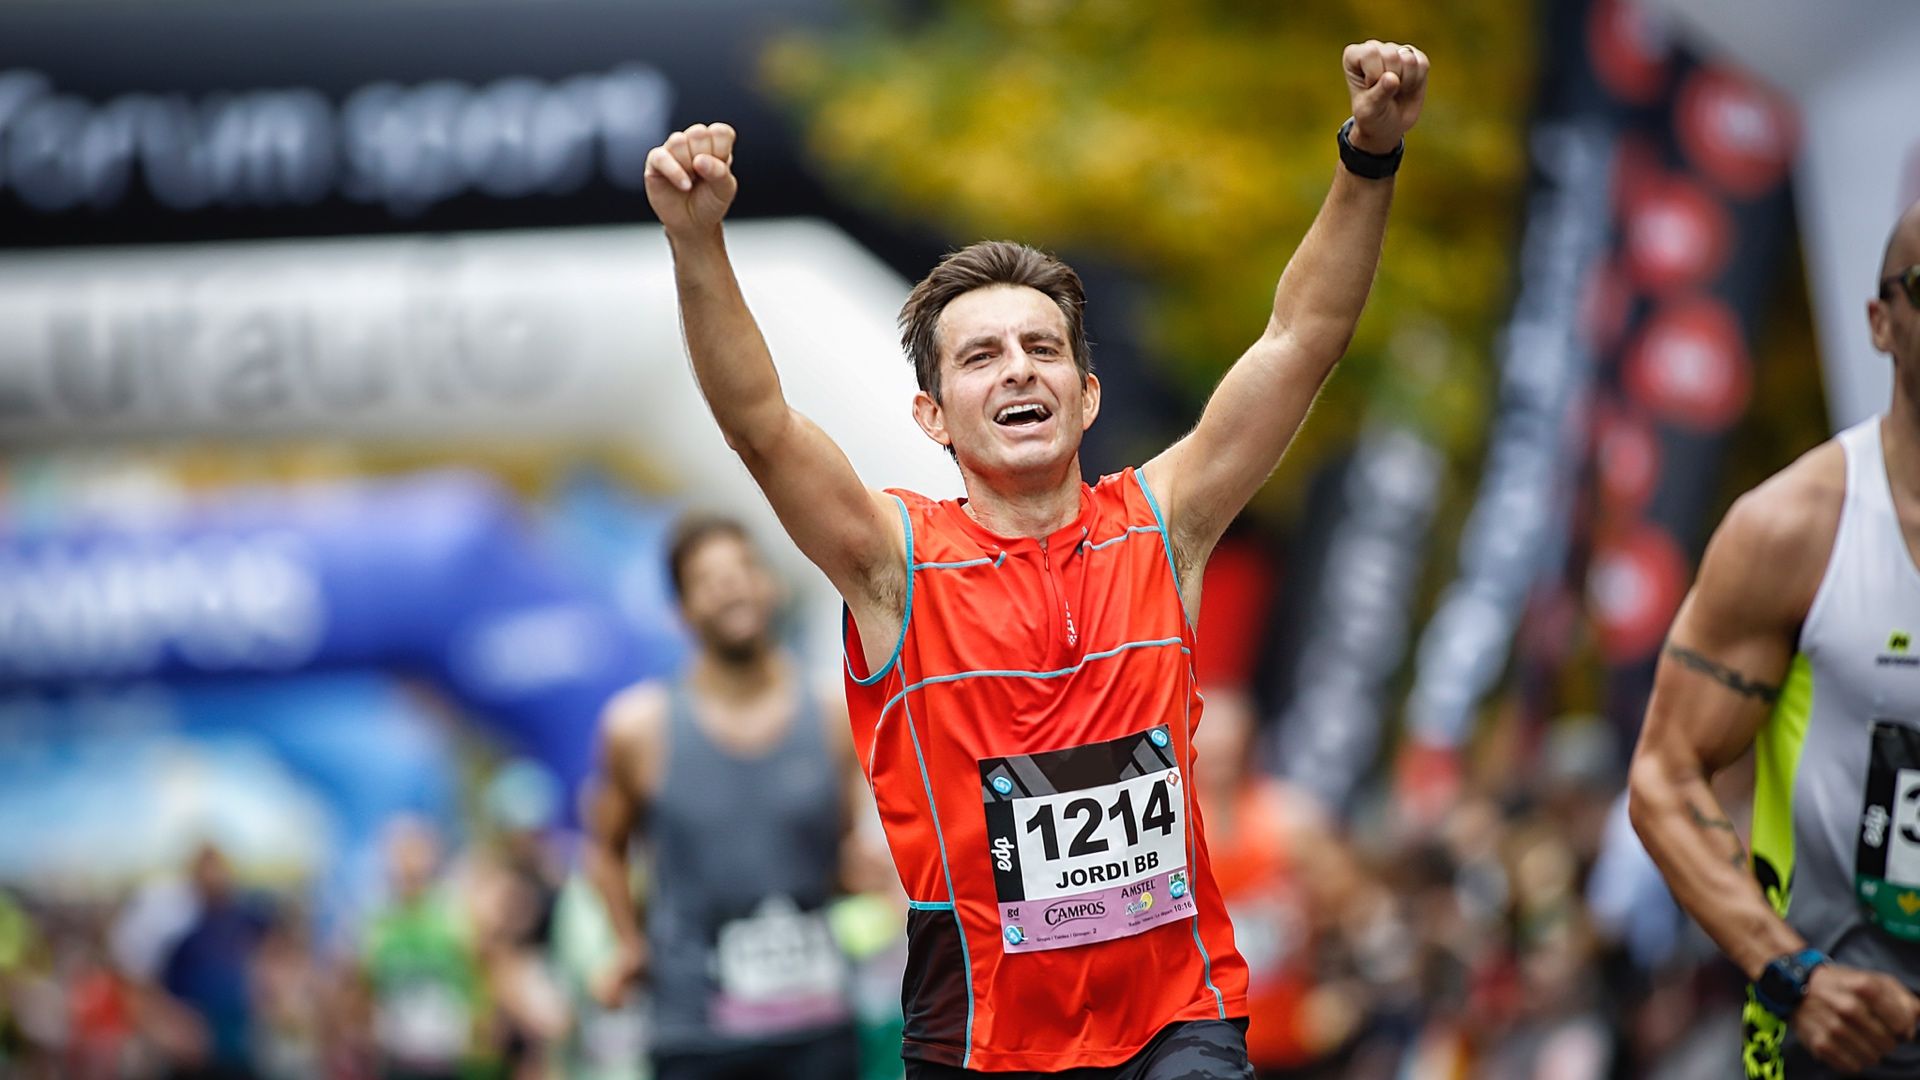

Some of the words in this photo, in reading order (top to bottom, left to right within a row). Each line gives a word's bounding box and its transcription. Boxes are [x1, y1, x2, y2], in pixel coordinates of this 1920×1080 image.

[1026, 779, 1176, 861] 1214
[991, 836, 1015, 872] edp
[1056, 861, 1129, 889] JORDI
[1135, 851, 1160, 874] BB
[1121, 880, 1155, 898] AMSTEL
[1007, 907, 1020, 918] gd
[1044, 901, 1106, 926] CAMPOS
[1173, 901, 1193, 912] 10:16
